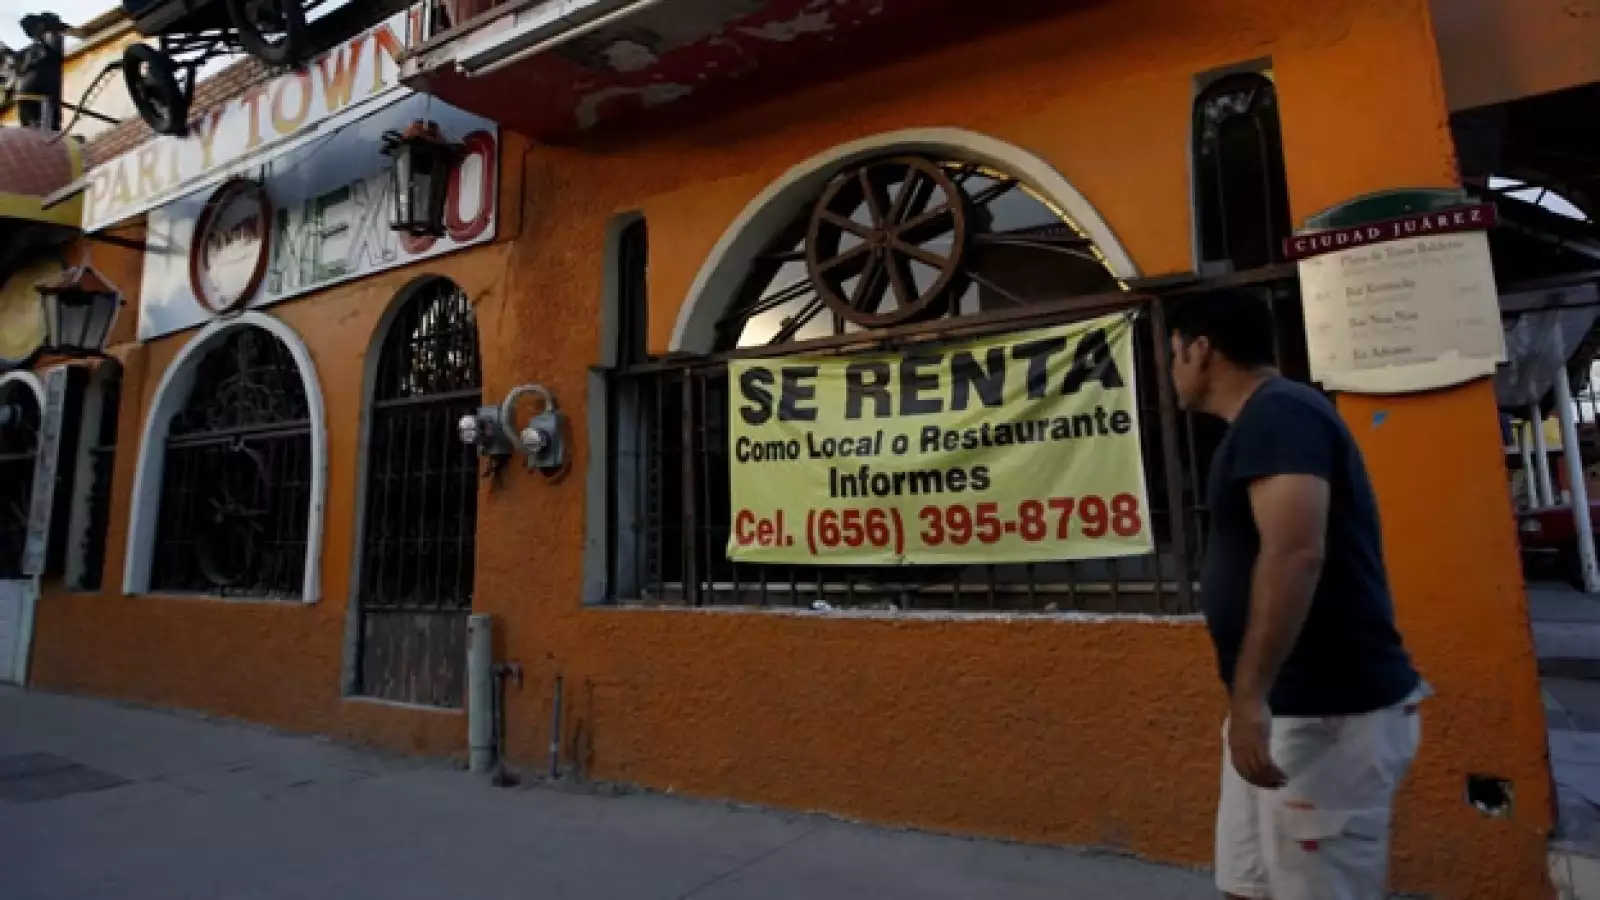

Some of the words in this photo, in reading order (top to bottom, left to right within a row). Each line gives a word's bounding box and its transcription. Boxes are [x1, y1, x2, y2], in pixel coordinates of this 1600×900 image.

[85, 110, 226, 224] PARTY
[241, 10, 423, 149] TOWN
[1295, 227, 1380, 252] CIUDAD
[740, 366, 819, 425] SE
[845, 328, 1124, 419] RENTA
[736, 435, 800, 463] Como
[807, 430, 883, 459] Local
[892, 434, 908, 455] o
[920, 405, 1131, 453] Restaurante
[829, 464, 990, 498] Informes
[735, 508, 793, 547] Cel.
[806, 507, 904, 555] (656)
[918, 492, 1141, 546] 395-8798
